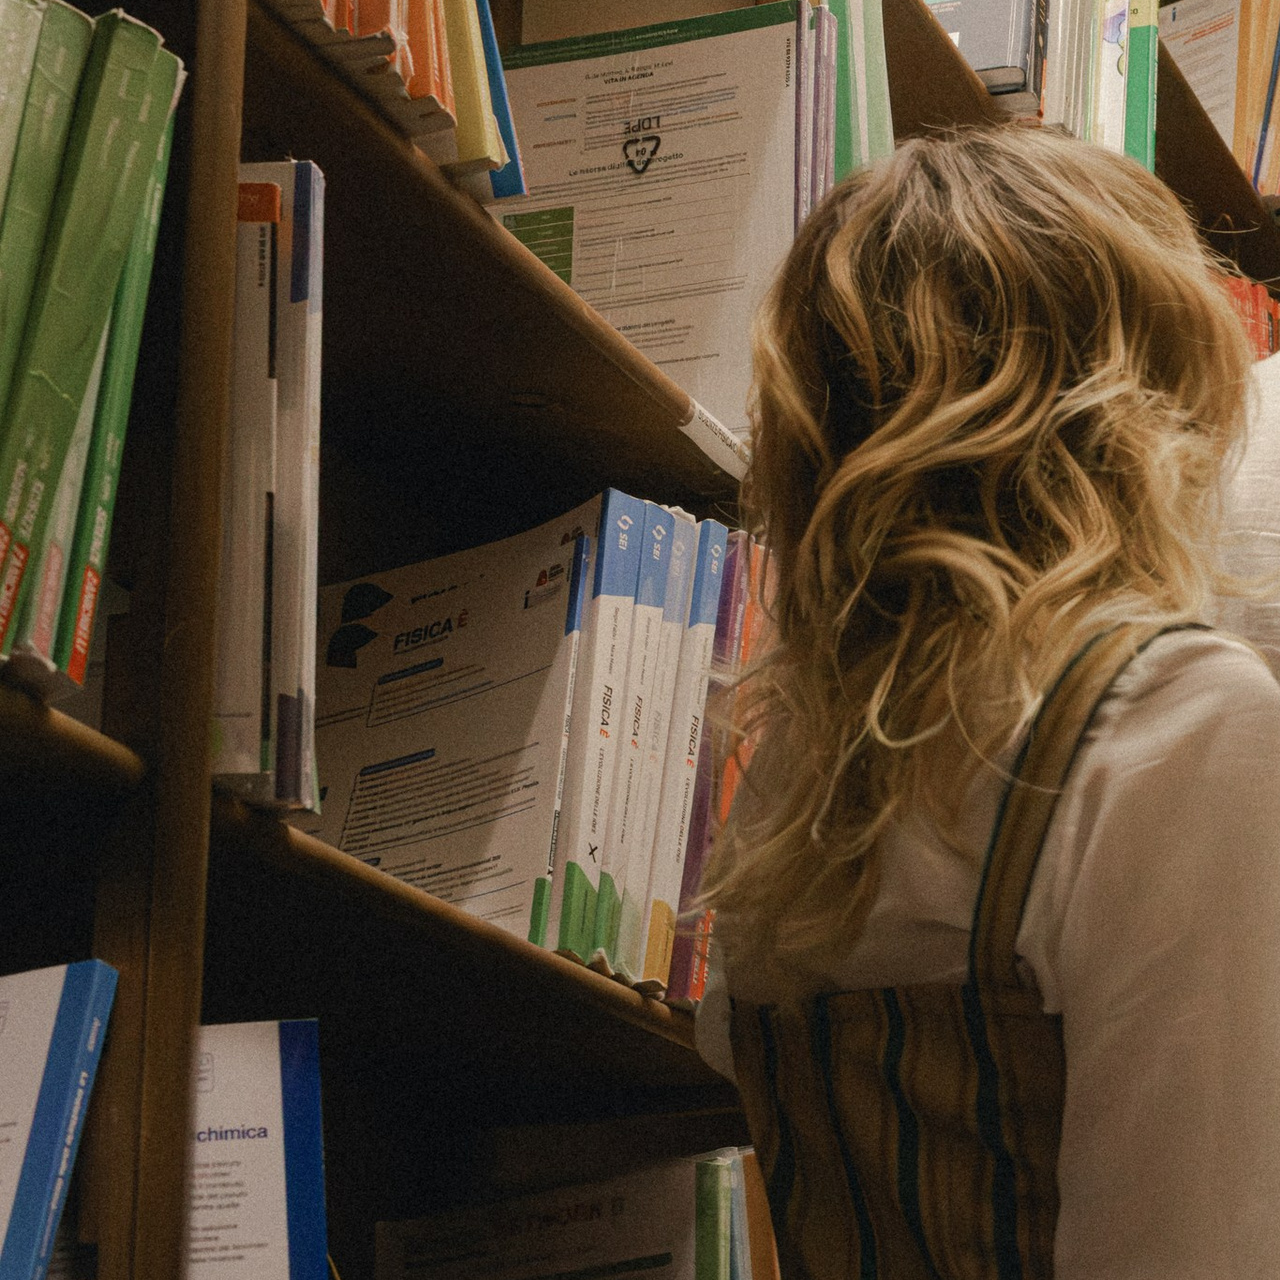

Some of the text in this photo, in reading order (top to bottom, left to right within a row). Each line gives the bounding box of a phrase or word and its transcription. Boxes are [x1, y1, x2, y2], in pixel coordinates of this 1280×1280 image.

[604, 71, 654, 85] VITA IN AGENDA
[624, 115, 661, 135] LDPE
[618, 532, 629, 551] SEI
[652, 542, 662, 561] SEI
[711, 559, 720, 575] SEI
[74, 567, 98, 655] ZANICHELLI
[393, 608, 470, 650] FISICA È
[599, 684, 613, 739] FISICA È
[632, 695, 643, 738] FISICA
[686, 714, 700, 769] FISICA È
